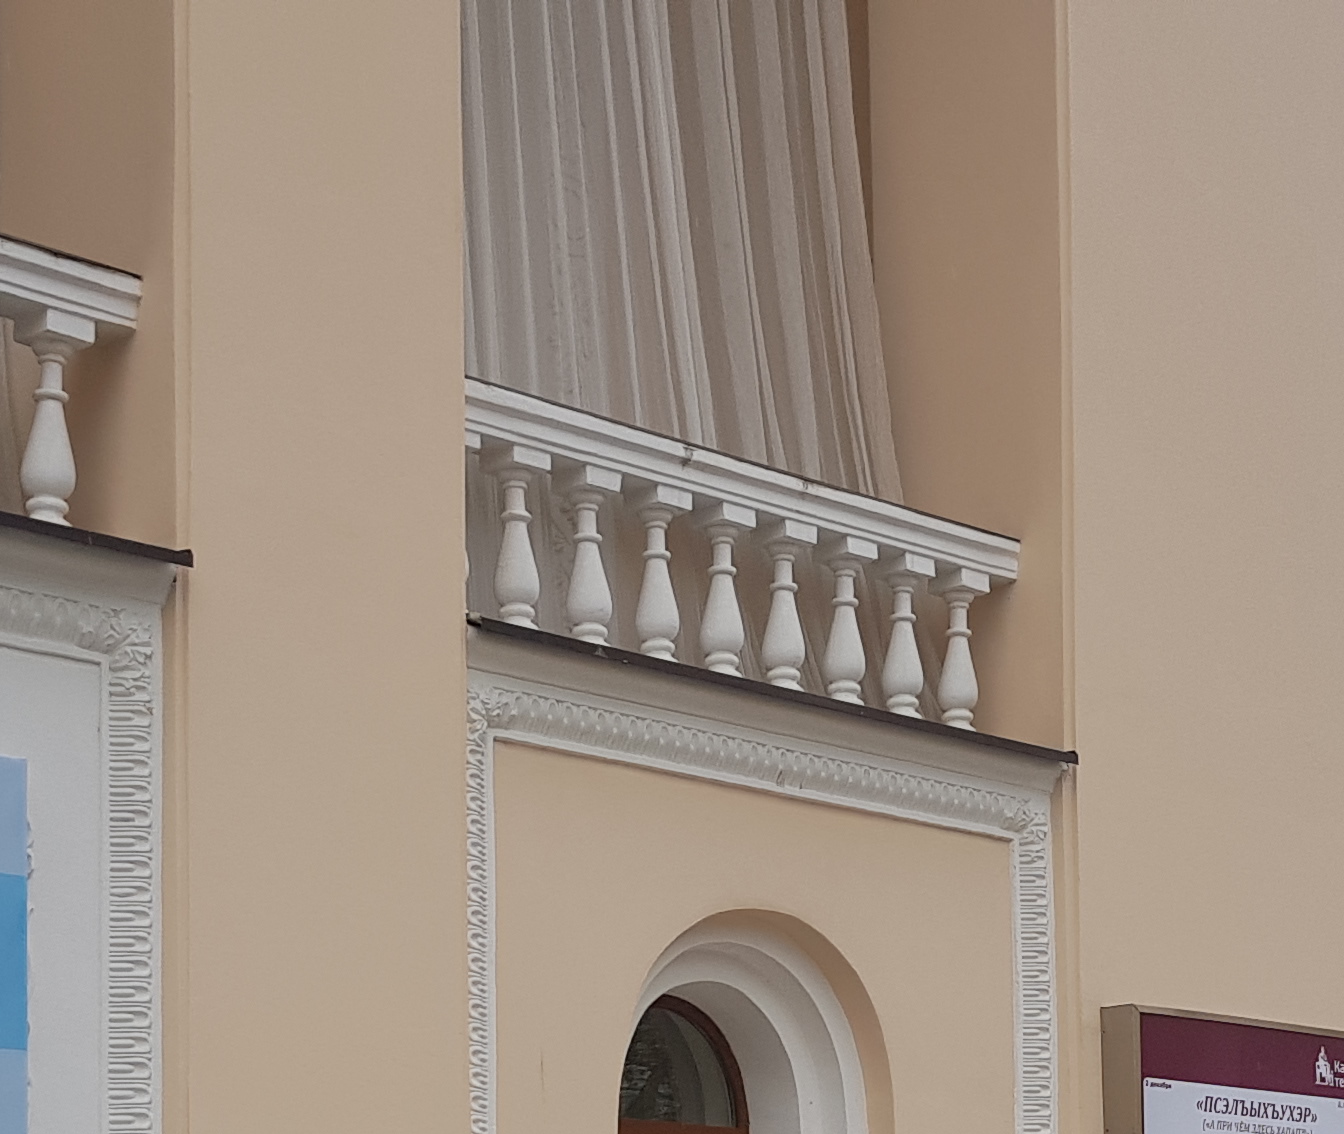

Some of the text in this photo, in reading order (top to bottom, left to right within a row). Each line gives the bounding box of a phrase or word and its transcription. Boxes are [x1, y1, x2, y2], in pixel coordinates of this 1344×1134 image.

[1196, 1096, 1318, 1123] «ПСЭЛЪЫХЪУХЭР»
[1217, 1120, 1233, 1131] ПРИ
[1235, 1120, 1250, 1132] ЧЁМ
[1251, 1123, 1275, 1134] ЗДЕСЬ
